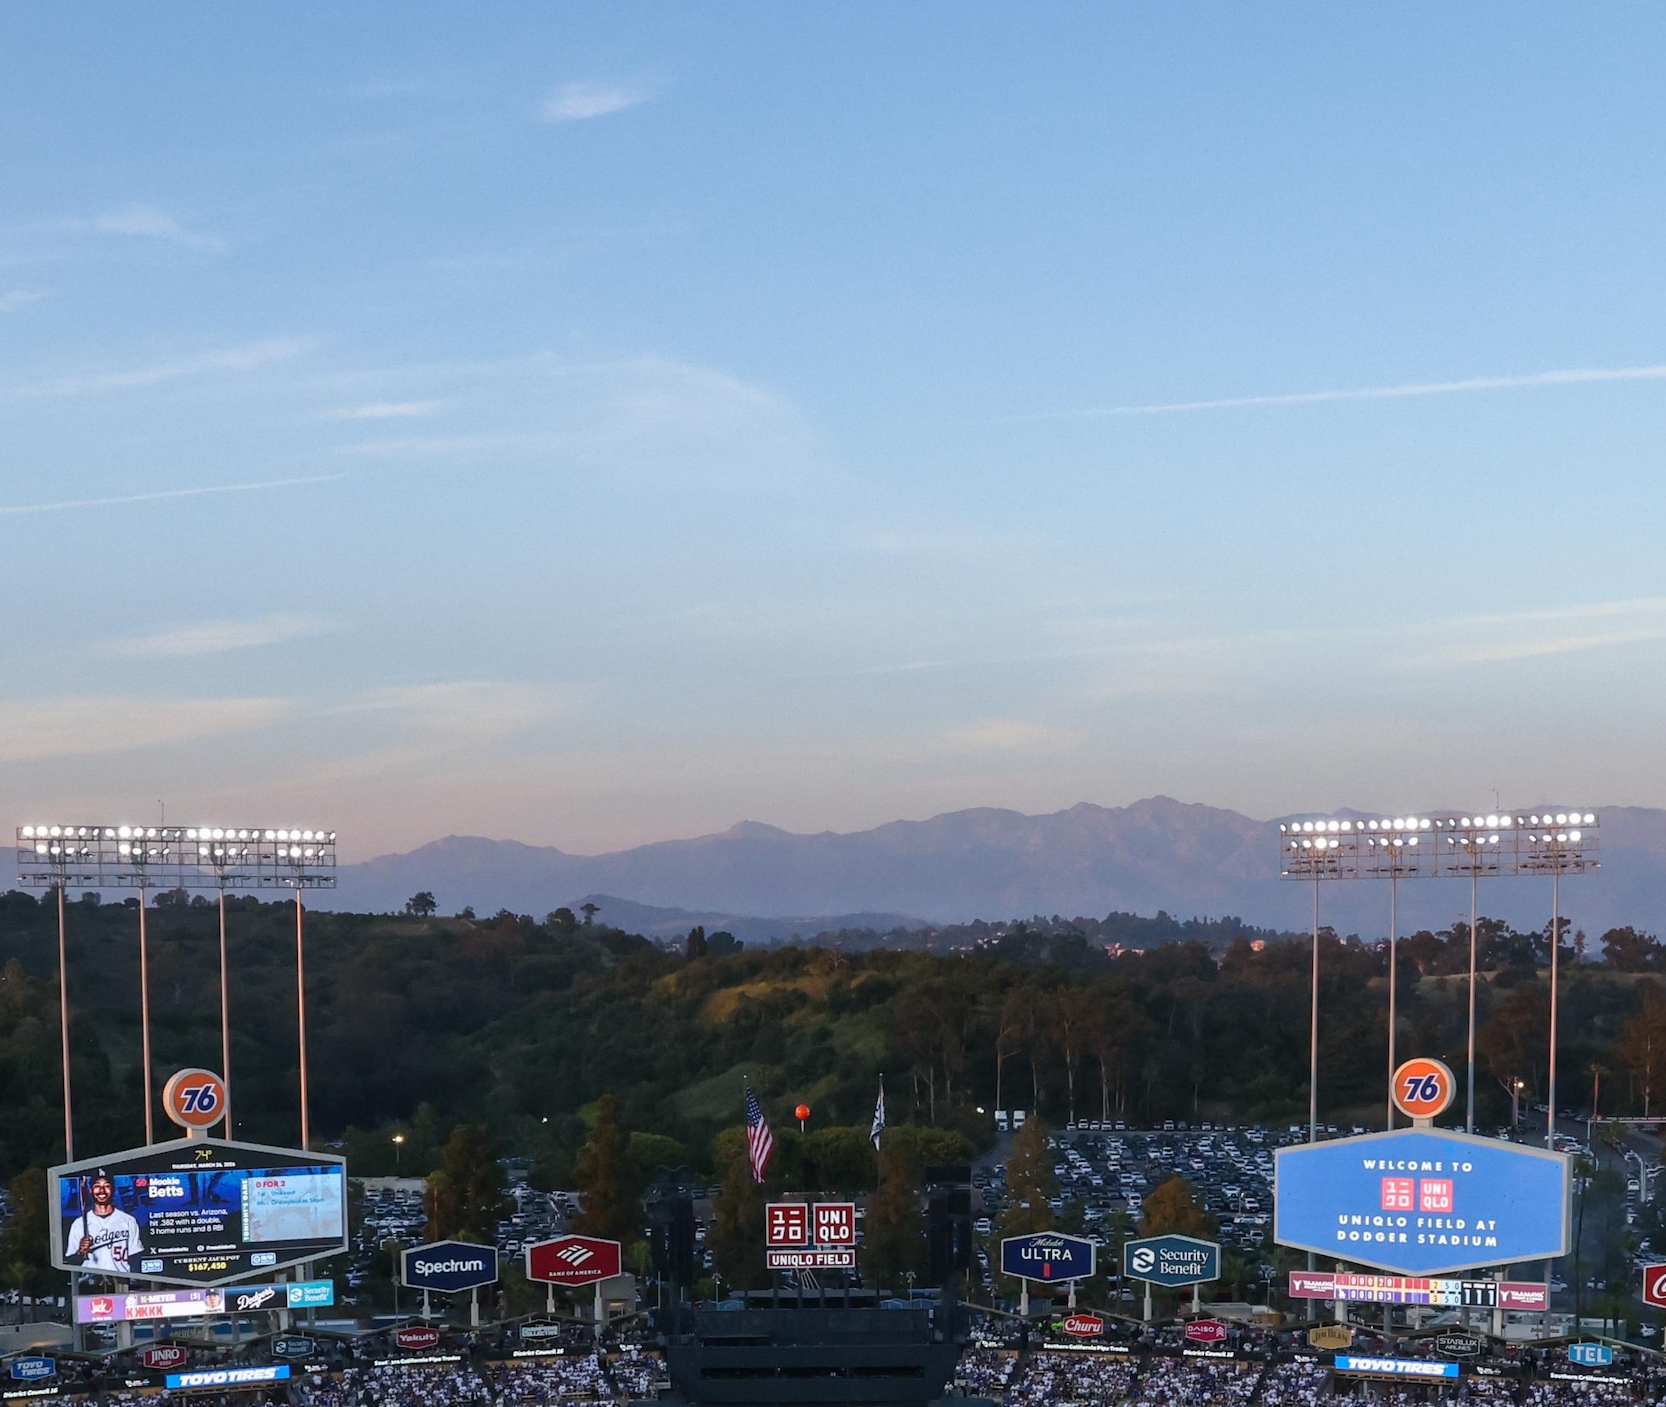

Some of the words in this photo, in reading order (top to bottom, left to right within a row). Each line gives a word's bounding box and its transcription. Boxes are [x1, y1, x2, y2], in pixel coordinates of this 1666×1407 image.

[1404, 1073, 1440, 1103] 76
[180, 1083, 218, 1113] 76
[1363, 1159, 1443, 1173] WELCOME
[1452, 1161, 1473, 1173] TO
[149, 1177, 180, 1187] Mookie
[263, 1180, 279, 1188] FOR
[1385, 1182, 1409, 1194] ユニ
[148, 1186, 184, 1198] Betts
[1423, 1183, 1447, 1195] UNI
[1423, 1196, 1449, 1209] QLO
[773, 1210, 801, 1224] ユニ
[819, 1210, 847, 1224] UNI
[1338, 1214, 1408, 1228] UNIQLO
[1417, 1217, 1466, 1230] FIELD
[1475, 1220, 1497, 1231] AT
[772, 1226, 801, 1240] クロ
[819, 1226, 849, 1241] QLO
[1337, 1230, 1408, 1244] DODGER
[1417, 1233, 1497, 1248] STADIUM
[208, 1254, 241, 1262] JACKPOT
[772, 1254, 813, 1267] UNIQLO
[816, 1254, 850, 1265] FIELD
[1021, 1248, 1073, 1261] ULTRA
[1159, 1248, 1210, 1263] Security
[188, 1262, 227, 1272] $167,450
[414, 1258, 483, 1277] Spectrum
[1160, 1262, 1203, 1275] Benefit
[303, 1285, 331, 1296] Security
[237, 1286, 275, 1310] Dodgers
[303, 1293, 329, 1302] Benefit
[1464, 1289, 1471, 1304] 1
[1476, 1289, 1483, 1305] 1
[1488, 1290, 1495, 1306] 1
[1064, 1319, 1102, 1333] Churu
[1187, 1325, 1215, 1333] DAISO
[399, 1333, 436, 1342] Yakult
[1439, 1337, 1478, 1346] STARLUX
[512, 1349, 534, 1357] District
[1044, 1342, 1069, 1350] Southern
[1069, 1343, 1097, 1351] California
[1097, 1345, 1110, 1353] Pipe
[151, 1348, 180, 1361] JINRO
[1575, 1346, 1608, 1363] TEL
[17, 1360, 44, 1370] TOYO
[1349, 1358, 1395, 1371] TOYO
[1395, 1361, 1445, 1375] TIRES
[21, 1367, 50, 1377] TIRES
[179, 1371, 226, 1386] TOYO
[225, 1367, 277, 1382] TIRES
[3, 1388, 26, 1398] District
[27, 1388, 48, 1397] Council
